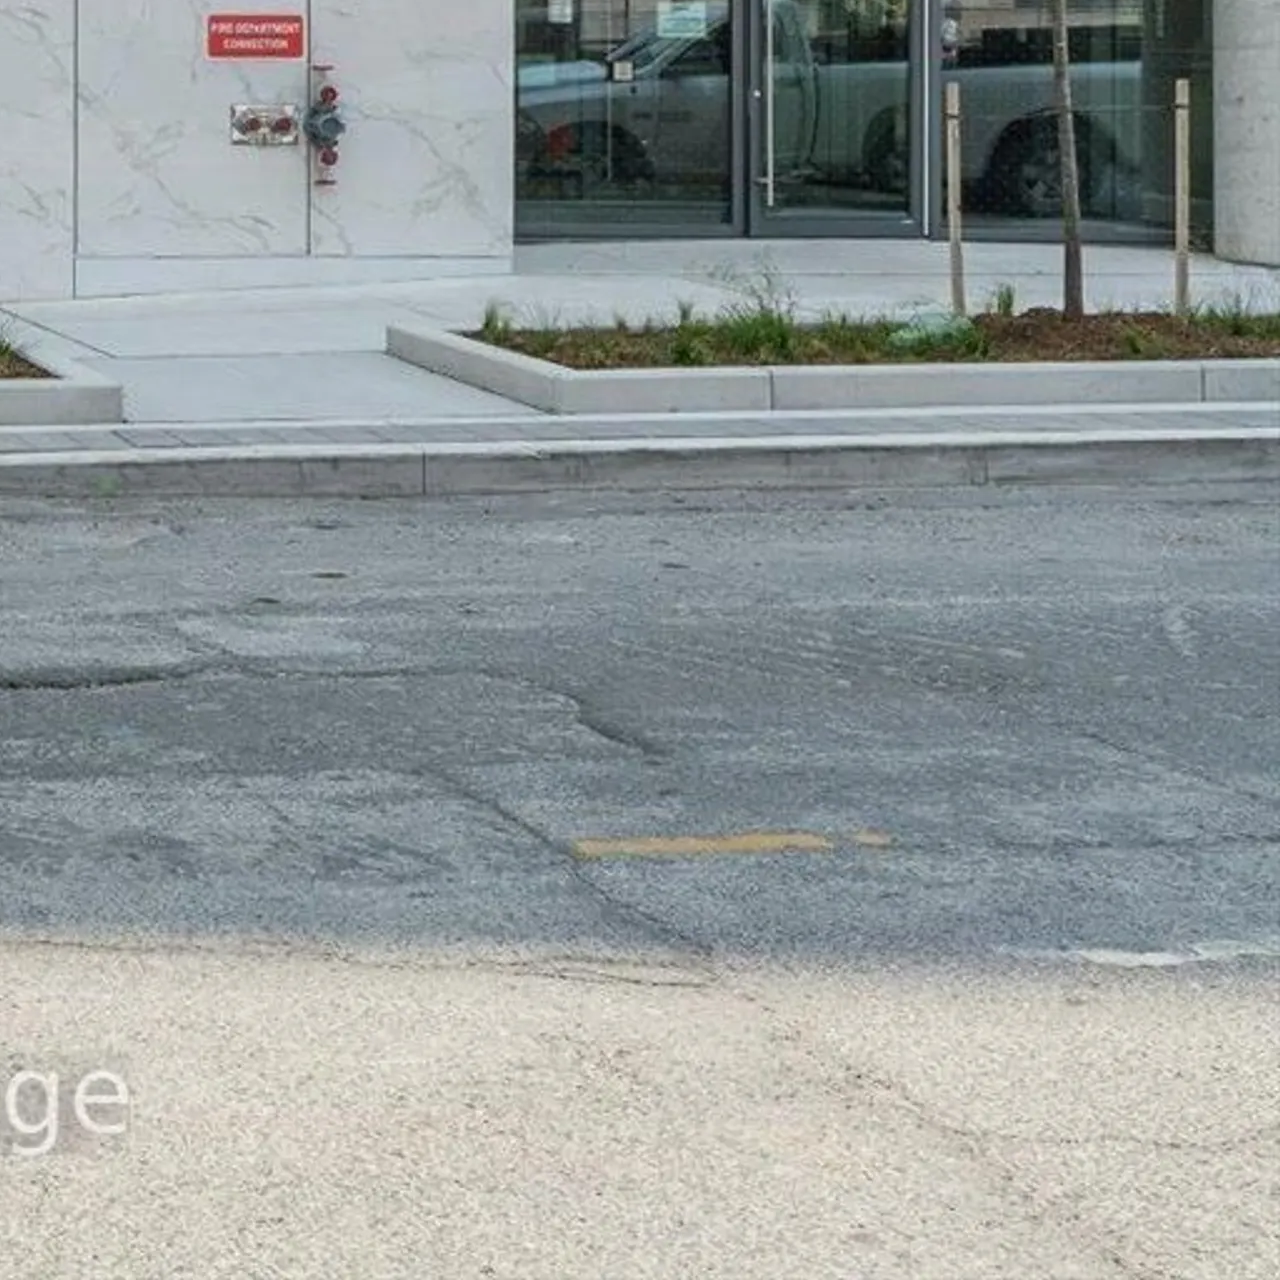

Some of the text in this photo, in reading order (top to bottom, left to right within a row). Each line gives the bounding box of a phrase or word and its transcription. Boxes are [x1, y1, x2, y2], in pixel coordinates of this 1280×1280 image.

[210, 22, 300, 35] FIRE DEPARTMENT
[222, 38, 289, 50] CONNECTION
